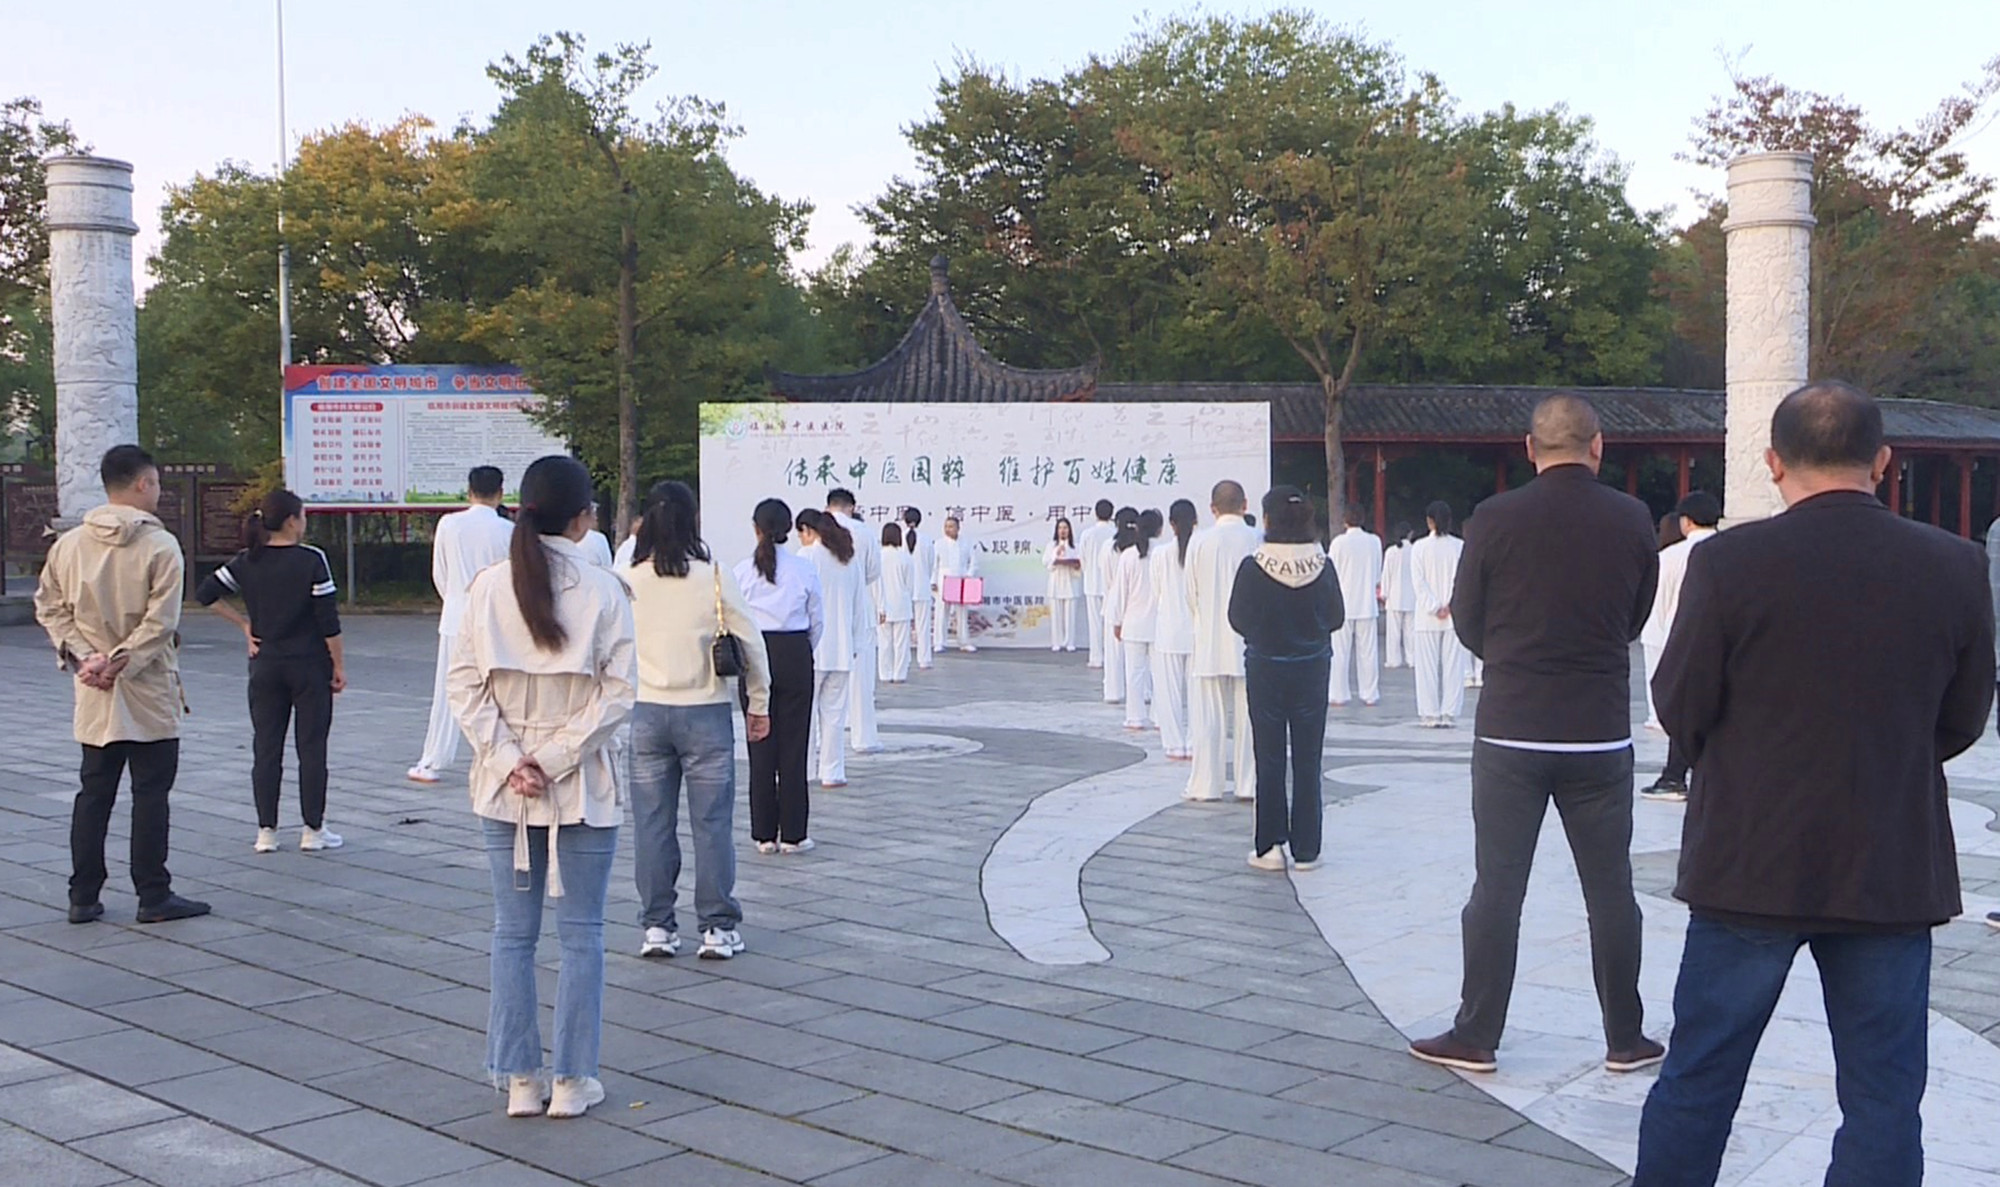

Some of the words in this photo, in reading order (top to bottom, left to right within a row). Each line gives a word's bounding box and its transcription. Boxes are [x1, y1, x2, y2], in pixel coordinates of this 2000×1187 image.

[317, 374, 438, 391] 创建全国文明城市
[453, 374, 543, 391] 争当文明市
[784, 454, 966, 490] 传承中医国粹
[999, 453, 1180, 488] 维护百姓健康
